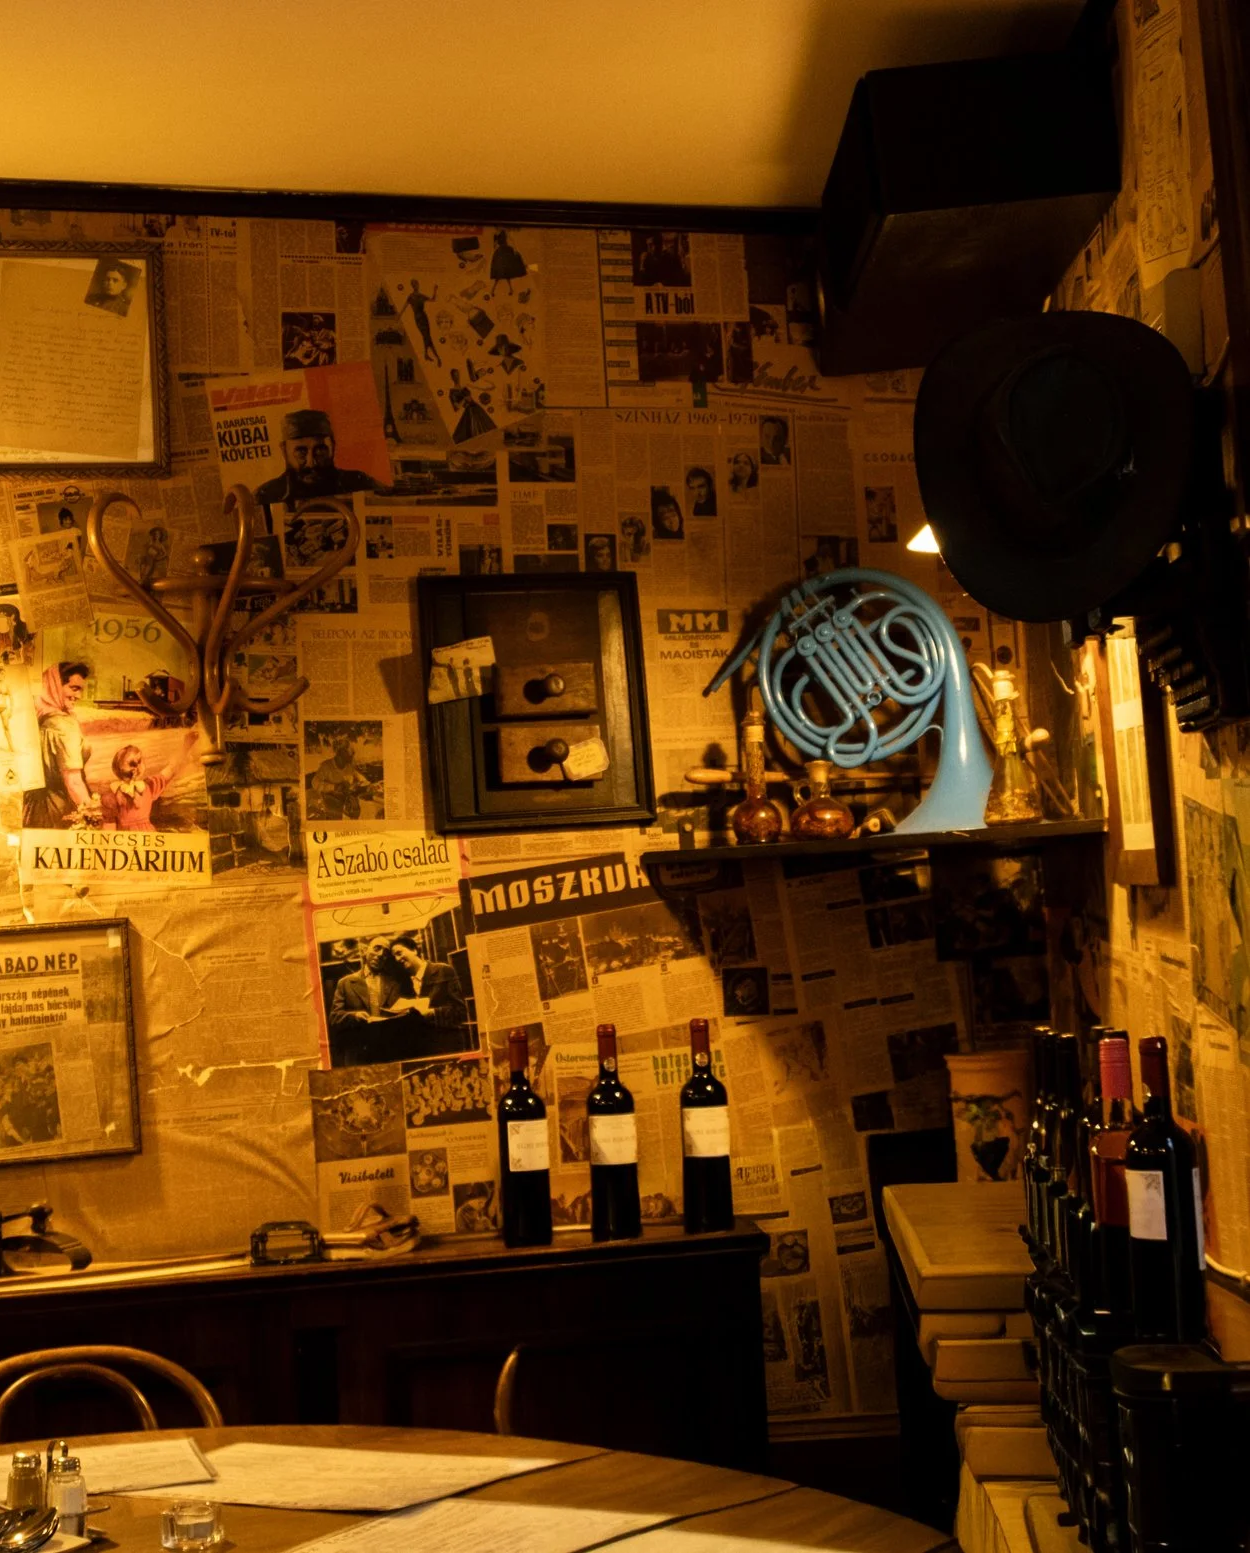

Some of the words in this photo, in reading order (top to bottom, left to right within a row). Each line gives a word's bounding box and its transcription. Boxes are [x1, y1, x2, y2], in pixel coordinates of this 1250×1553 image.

[217, 426, 269, 448] KUBAI
[220, 445, 272, 463] KÖVETEI
[88, 618, 161, 643] 1956
[76, 832, 166, 848] KINCSES
[33, 846, 205, 872] KALENDÁRIUM
[317, 850, 331, 878] A
[333, 841, 389, 877] Szabó
[45, 952, 79, 972] NÉP
